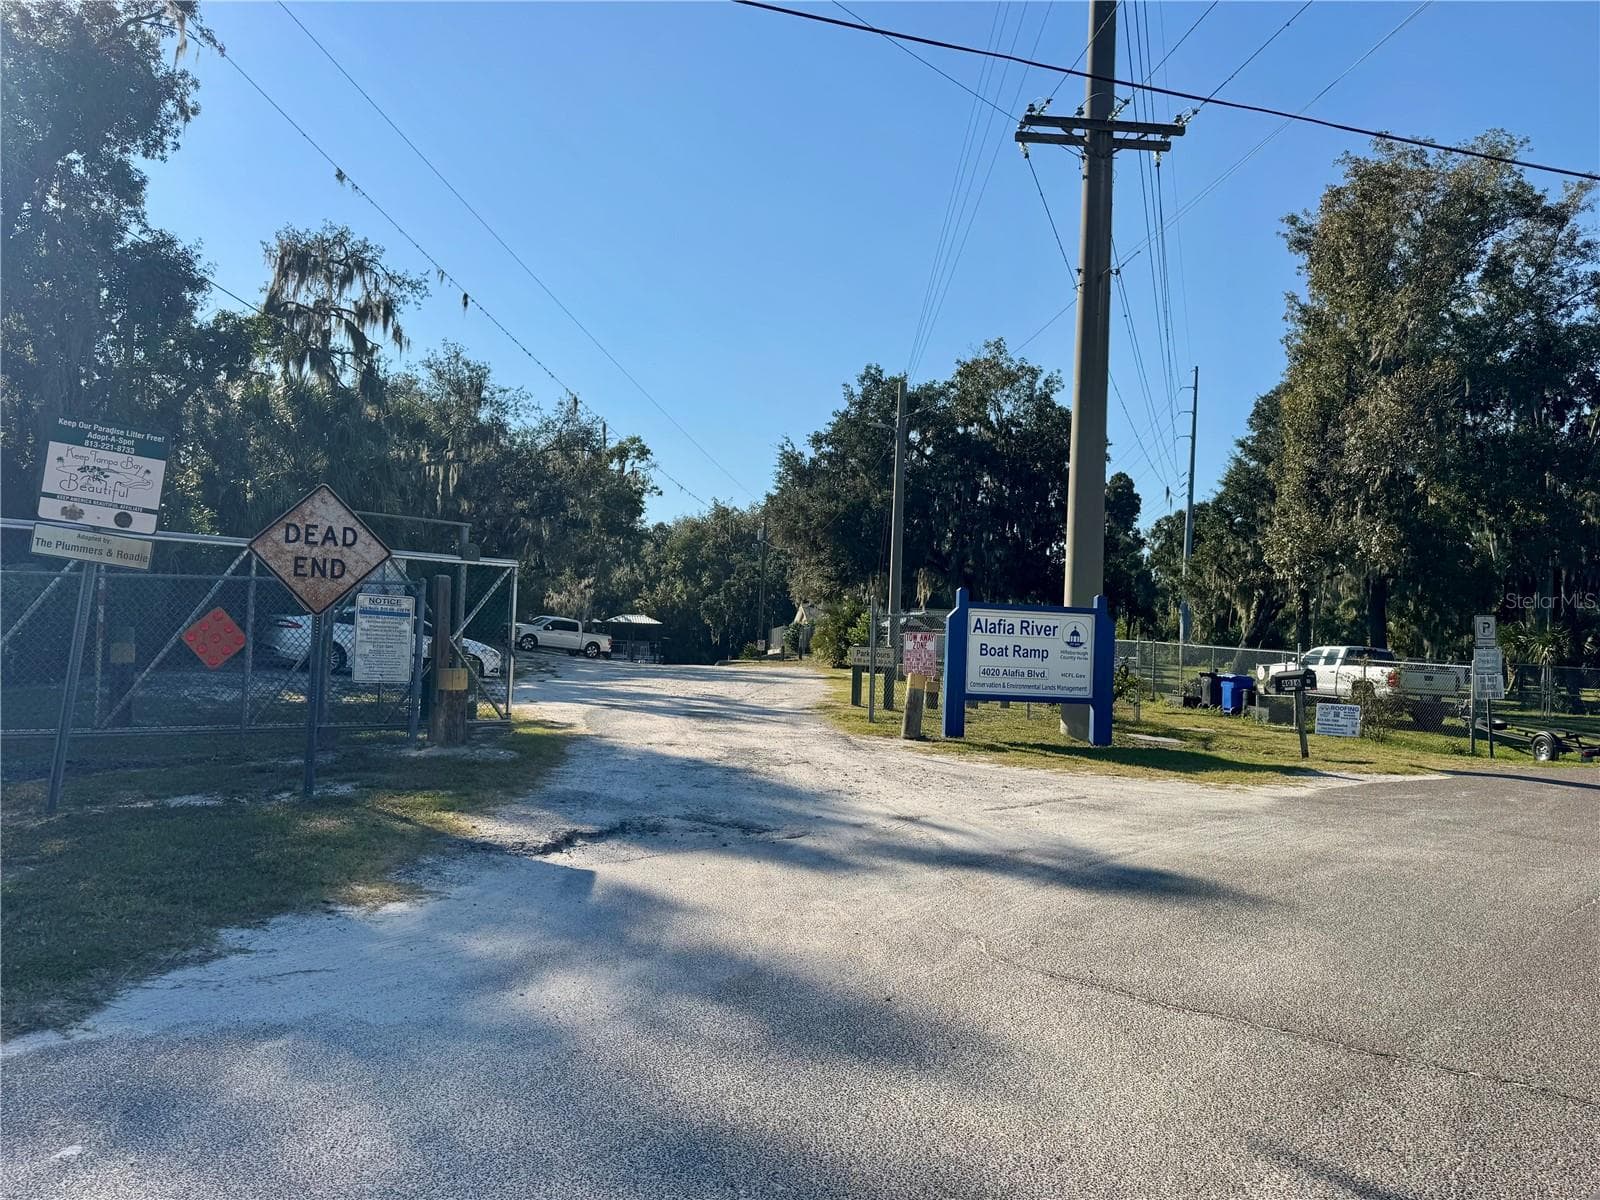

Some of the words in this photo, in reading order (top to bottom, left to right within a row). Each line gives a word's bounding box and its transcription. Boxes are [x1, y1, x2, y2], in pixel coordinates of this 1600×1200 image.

[58, 417, 77, 428] Keep
[78, 420, 92, 430] Our
[93, 424, 125, 436] Paradise
[126, 430, 145, 440] Litter
[146, 434, 165, 443] Free!
[87, 431, 134, 446] Adopt-A-Spot
[84, 439, 135, 454] 813-221-8733
[66, 446, 90, 465] Keep
[90, 450, 118, 470] Tampa
[120, 456, 143, 475] Bay
[59, 473, 129, 501] Beautiful
[284, 523, 358, 547] DEAD
[35, 537, 53, 548] The
[55, 540, 103, 556] Plummers
[106, 550, 113, 558] &
[116, 550, 149, 563] Roadie
[293, 556, 346, 580] END
[368, 597, 402, 605] NOTICE
[905, 632, 918, 642] TOW
[919, 633, 935, 642] AWAY
[972, 618, 1015, 635] Alafia
[1019, 620, 1058, 637] River
[912, 641, 928, 650] ZONE
[979, 643, 1009, 658] Boat
[1012, 645, 1049, 662] Ramp
[981, 668, 1000, 677] 4020
[1002, 668, 1025, 678] Alafia
[1026, 669, 1048, 679] Blvd.
[969, 680, 1002, 689] Conservation
[1006, 682, 1041, 690] Environmental
[1041, 683, 1056, 691] Lands
[1056, 684, 1088, 693] Management
